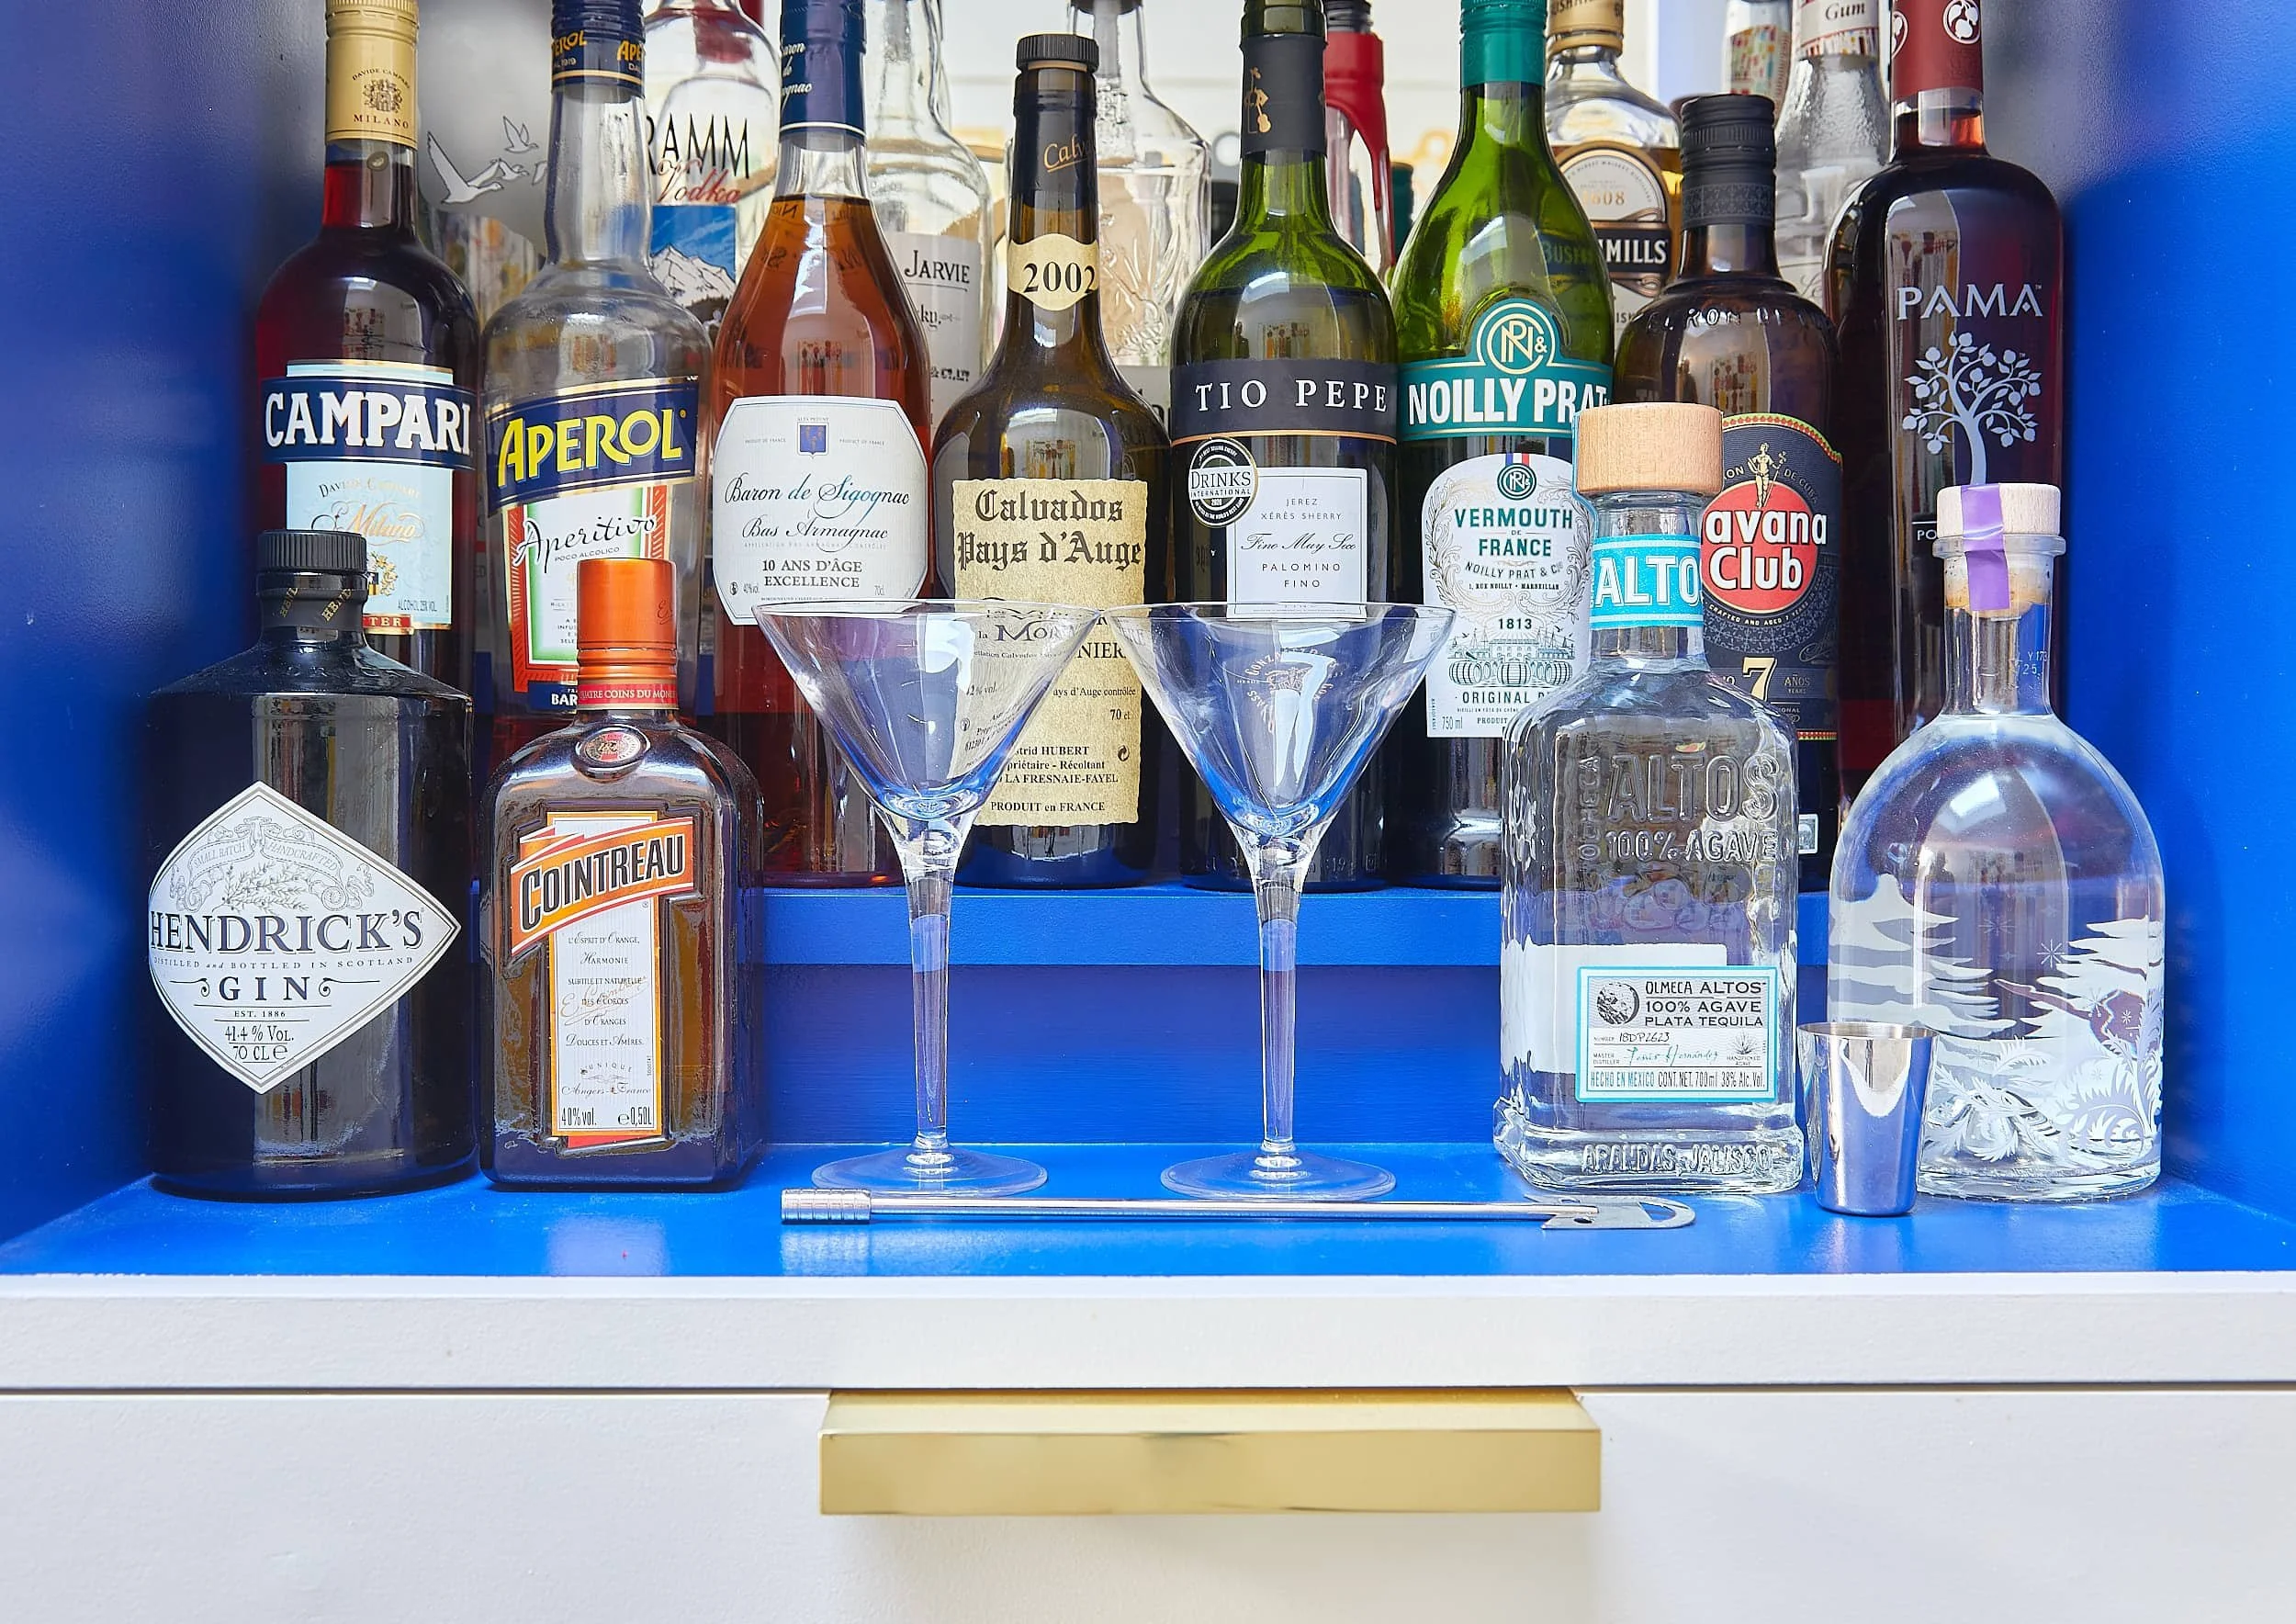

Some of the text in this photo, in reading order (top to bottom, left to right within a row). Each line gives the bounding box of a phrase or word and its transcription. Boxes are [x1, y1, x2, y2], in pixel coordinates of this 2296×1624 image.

[1825, 2, 1866, 21] Gum
[353, 114, 410, 130] MILANO
[656, 158, 743, 203] Vodka
[1601, 239, 1667, 265] MILLS
[904, 249, 971, 284] JARVIE
[1022, 261, 1097, 295] 2002
[1896, 282, 2043, 321] PAMA
[1195, 378, 1388, 413] TIO PEPE
[1408, 377, 1608, 425] NOILLY PRAT
[264, 390, 471, 456] CAMPARI
[497, 408, 682, 488] APEROL
[1190, 470, 1251, 490] DRINKS
[1723, 465, 1744, 480] ON
[1783, 468, 1798, 482] DE
[725, 472, 910, 527] Baron de Sigognac
[1189, 489, 1251, 498] INTERNATIONAL
[1286, 498, 1318, 506] JEREZ
[974, 488, 1123, 523] Calvados
[1300, 512, 1344, 520] SHERRY
[1454, 507, 1573, 530] VERMOUTH
[742, 509, 889, 552] Bas Armagnac
[1703, 508, 1828, 545] avana
[512, 513, 657, 574] Aperitivo
[957, 529, 1142, 571] Pays d'Auge
[1240, 533, 1278, 551] Fino
[1281, 532, 1325, 555] Muy
[1478, 538, 1552, 557] FRANCE
[554, 546, 621, 561] POCO ALCOLICO
[761, 558, 863, 573] 10 ANS D'ÂGE
[1261, 562, 1341, 572] PALOMINO
[1465, 561, 1548, 580] NOILLY PRAT &
[1708, 546, 1804, 591] Club
[763, 575, 861, 588] EXCELLENCE
[1283, 579, 1321, 588] FINO
[363, 616, 402, 627] TER
[1708, 603, 1741, 624] CRAFTED
[1498, 617, 1533, 630] 1813
[978, 630, 988, 639] la
[1741, 656, 1778, 702] 7
[1784, 672, 1810, 687] AÑOS
[604, 689, 636, 699] COINS
[636, 688, 651, 698] DU
[1070, 686, 1137, 698] d'Auge contrôlée
[1462, 691, 1531, 705] ORIGINAL
[1109, 708, 1122, 721] 70
[1455, 716, 1463, 729] ml
[1041, 745, 1090, 756] HUBERT
[1059, 759, 1106, 770] Récoltant
[1005, 773, 1119, 784] LA FRESNAIE-FAYEL
[1607, 752, 1780, 824] ALTOS
[990, 801, 1106, 812] PRODUIT en FRANCE
[1605, 829, 1779, 863] 100% AGAVE
[192, 849, 220, 869] SMALL
[265, 840, 339, 871] HANDCRAFTED
[521, 835, 684, 932] COINTREAU
[149, 908, 423, 955] HENDRICK'S
[152, 956, 413, 970] DISTILLED and BOTTLED IN SCOTLAND
[580, 951, 629, 965] HARMONIE
[218, 976, 310, 1001] GIN
[1645, 980, 1762, 995] OLMECA ALTOS
[234, 1009, 287, 1019] EST. 1886
[1645, 1000, 1761, 1013] 100% AGAVE
[1644, 1016, 1763, 1028] PLATA TEQUILA
[231, 1044, 270, 1061] 70 CL
[1590, 1071, 1615, 1088] HECHO
[1616, 1071, 1626, 1088] EN
[1627, 1071, 1655, 1088] MEXICO
[1694, 1071, 1718, 1088] 700ml
[1720, 1070, 1737, 1088] 38%
[1738, 1070, 1752, 1088] Alc.
[561, 1106, 652, 1128] 40% vol. 0,50L
